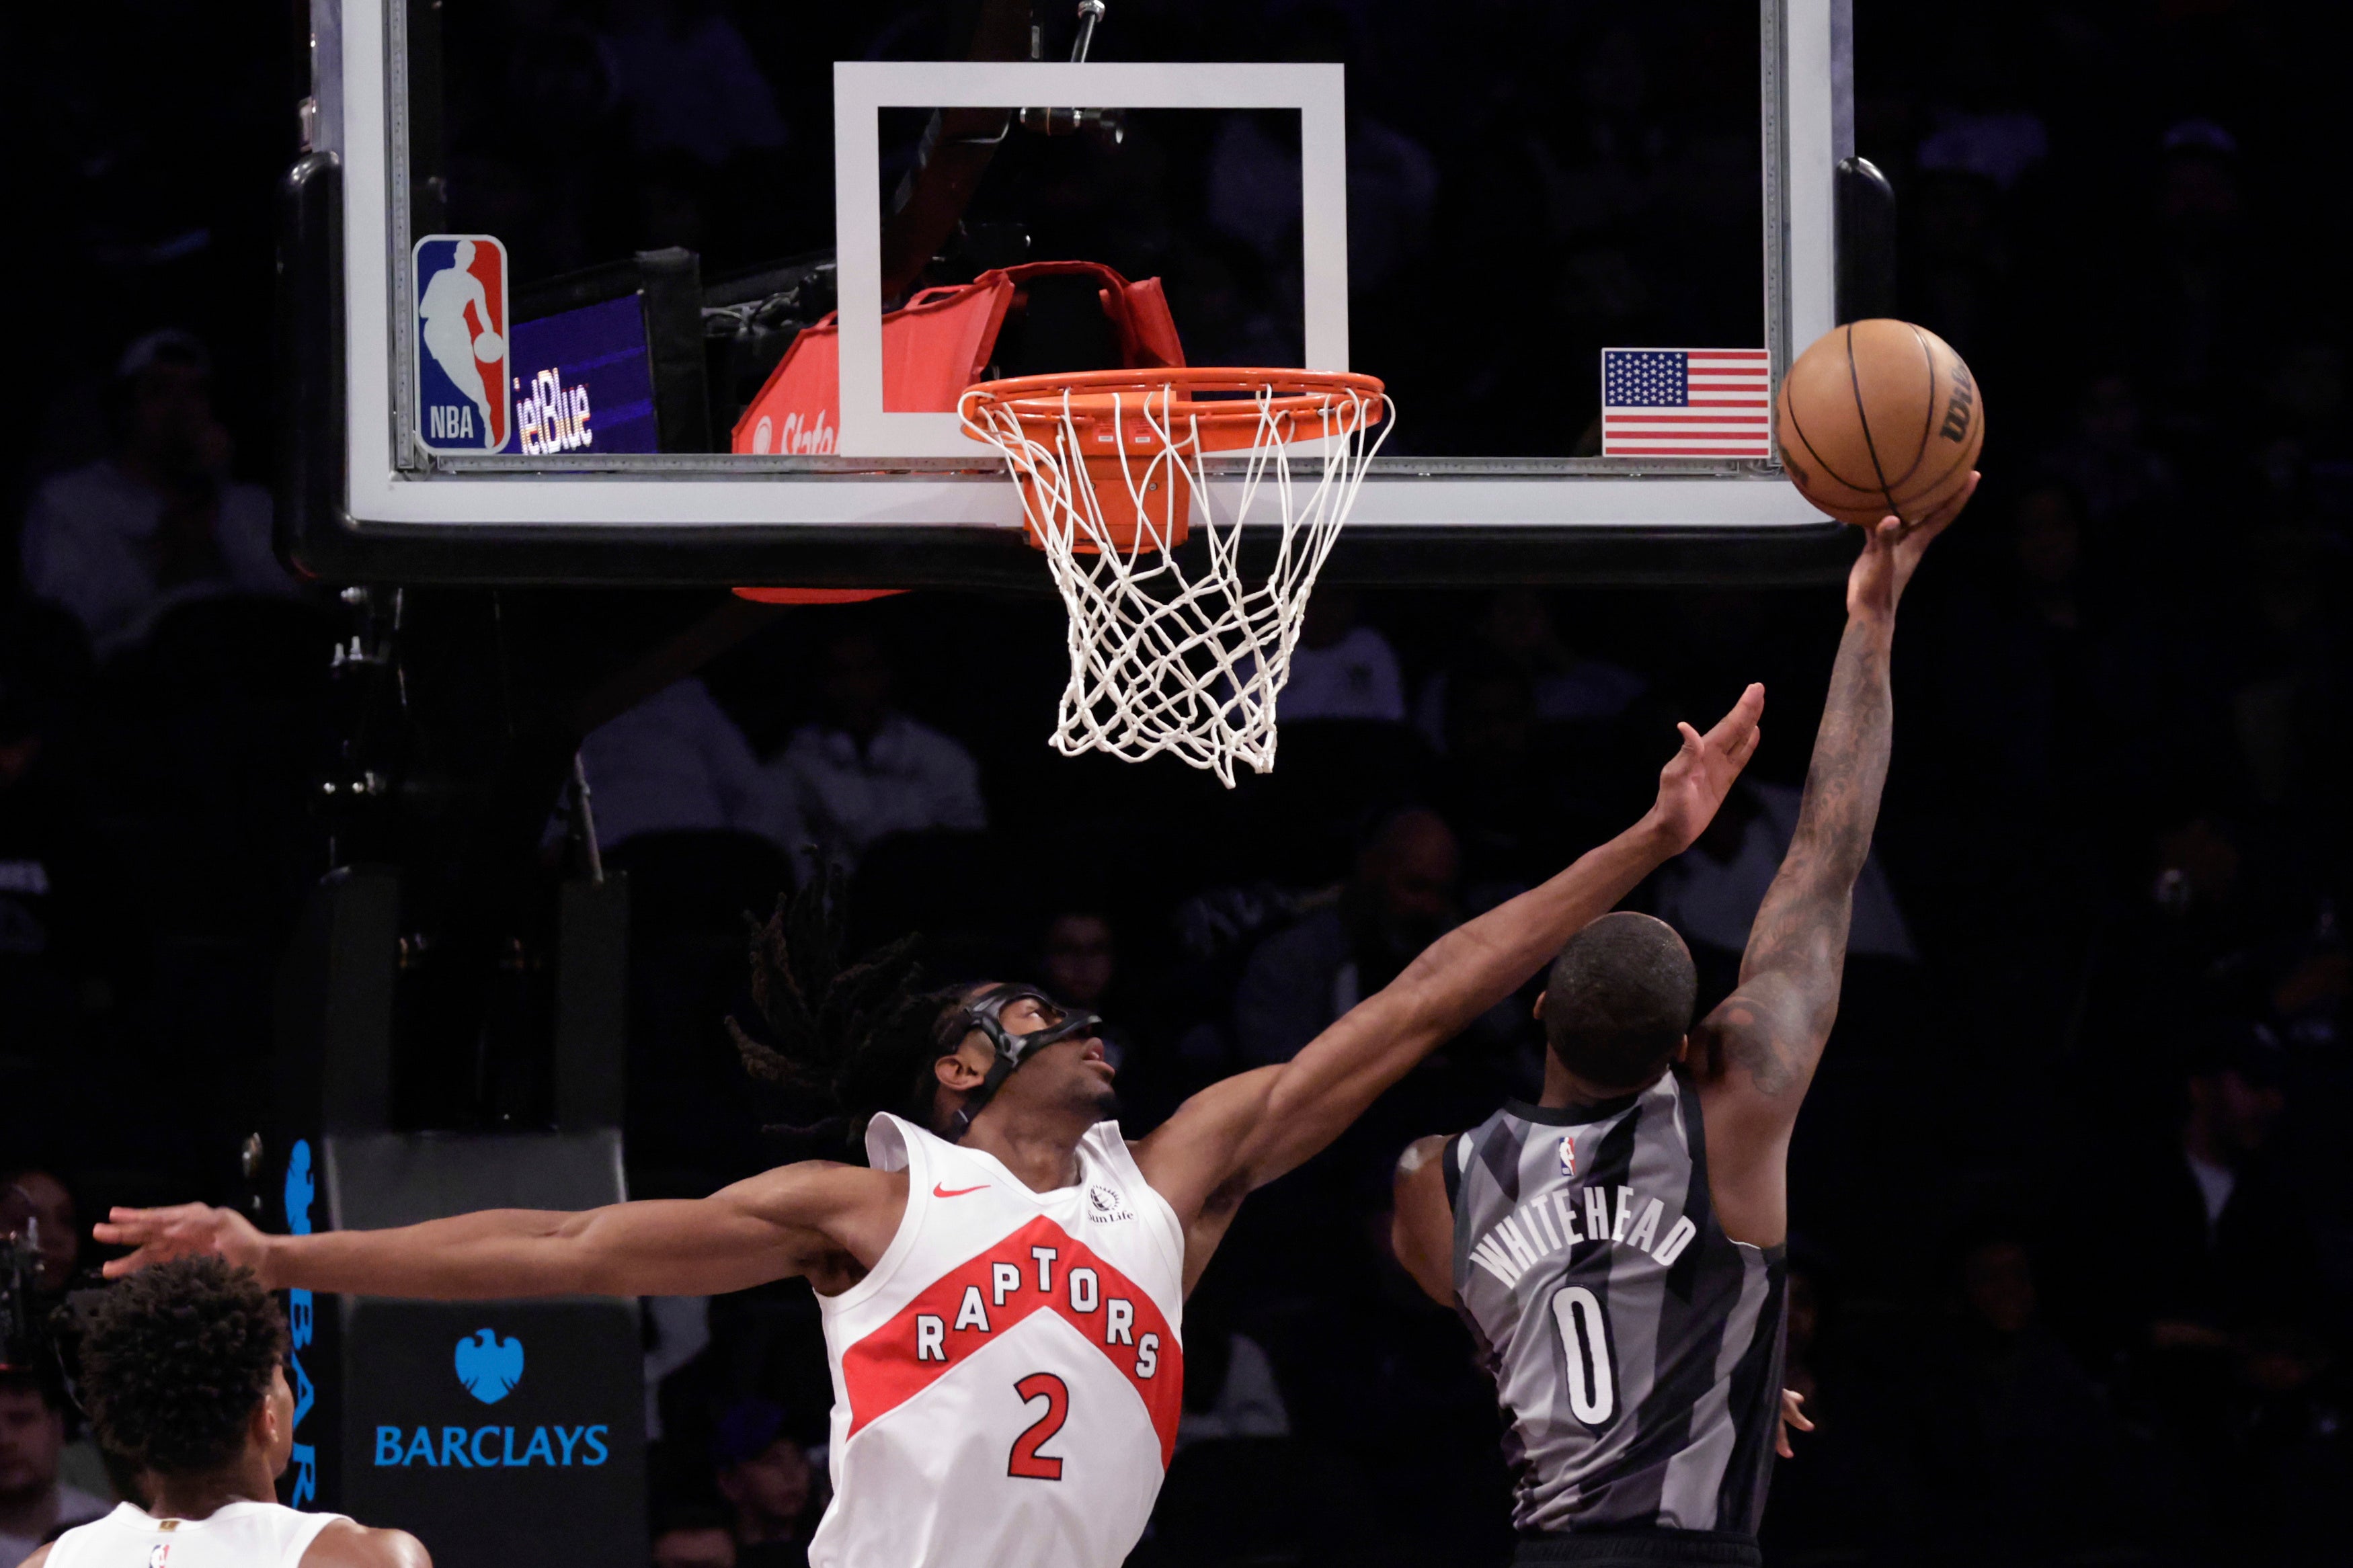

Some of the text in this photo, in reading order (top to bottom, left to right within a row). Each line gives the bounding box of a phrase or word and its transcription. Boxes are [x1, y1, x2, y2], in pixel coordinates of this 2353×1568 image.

[430, 406, 474, 439] NBA
[513, 367, 593, 455] jetBlue
[1088, 1210, 1133, 1223] Sun Life
[1469, 1185, 1697, 1289] WHITEHEAD
[916, 1246, 1159, 1378] RAPTORS
[1552, 1286, 1613, 1425] 0
[374, 1426, 608, 1467] BARCLAYS
[1007, 1372, 1069, 1481] 2
